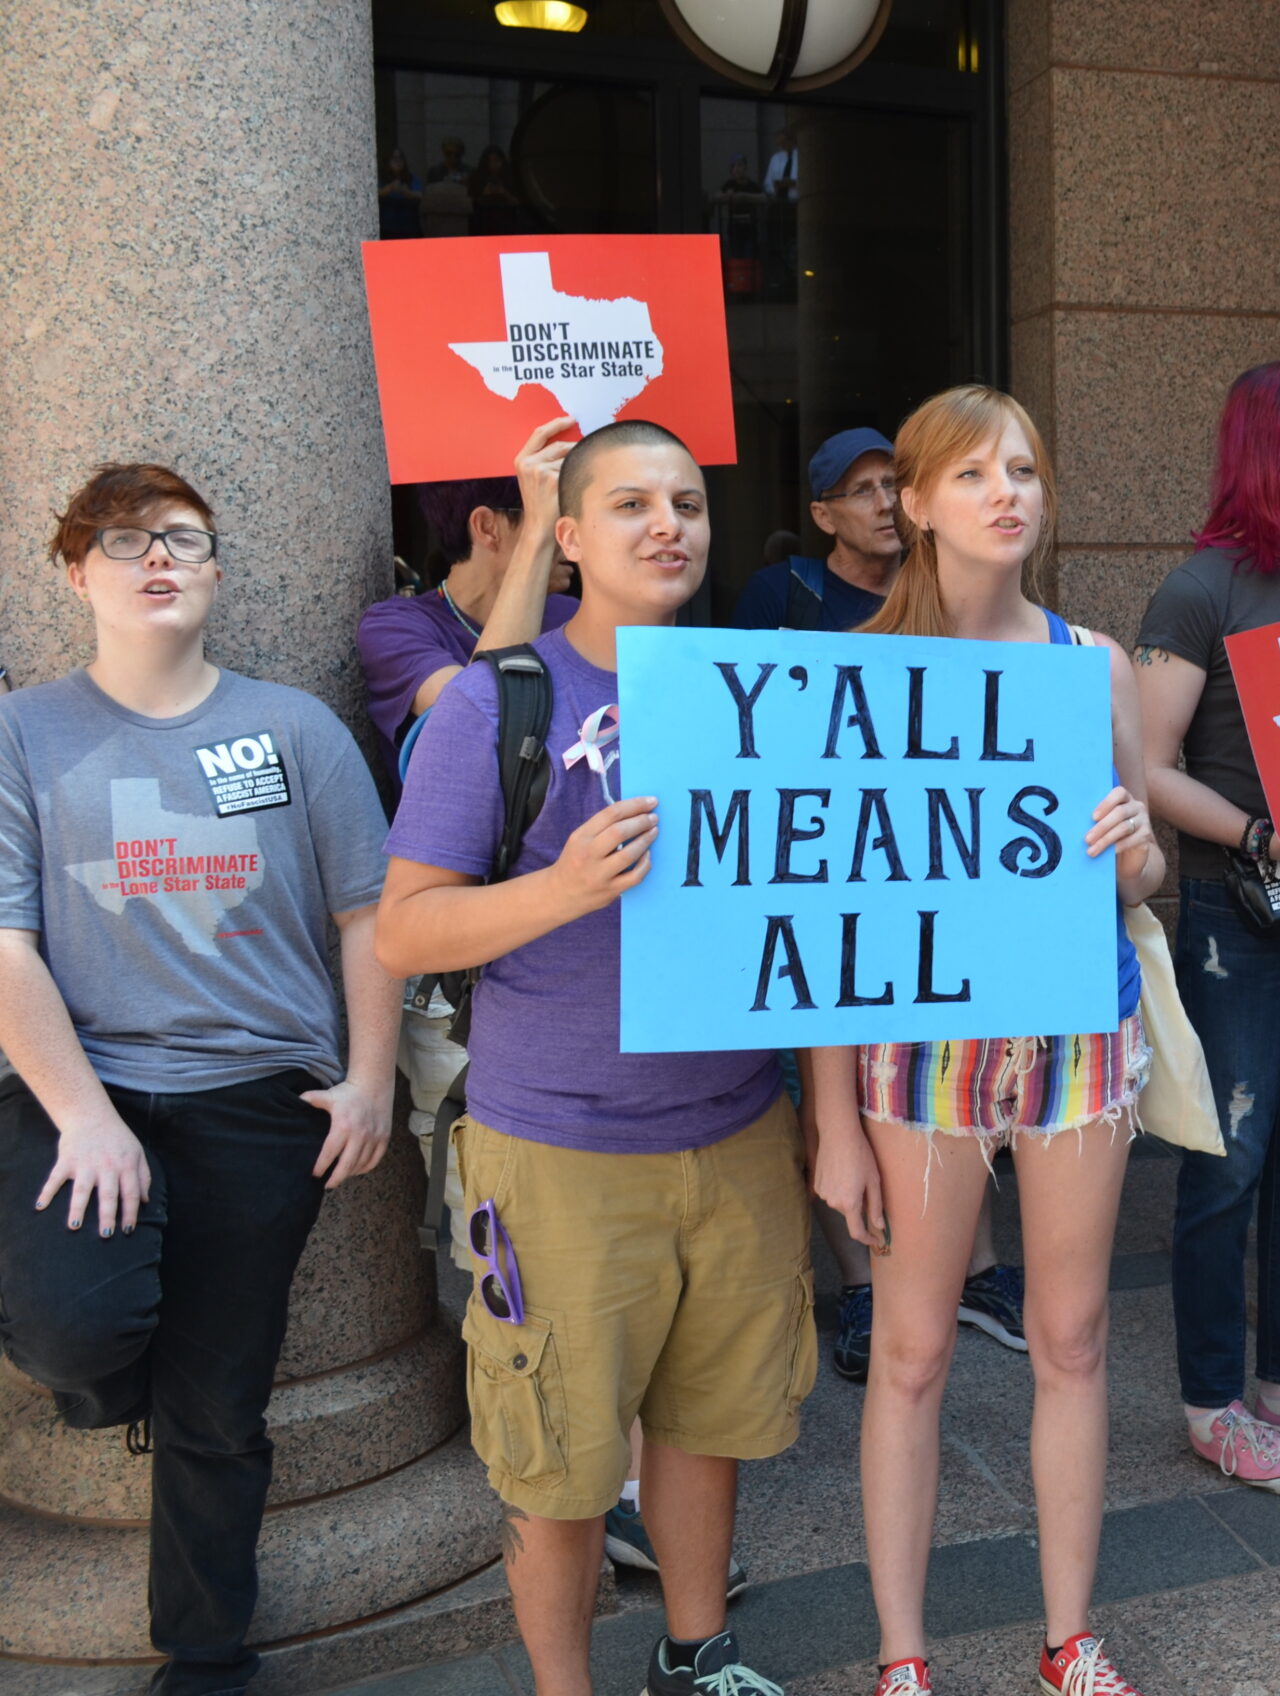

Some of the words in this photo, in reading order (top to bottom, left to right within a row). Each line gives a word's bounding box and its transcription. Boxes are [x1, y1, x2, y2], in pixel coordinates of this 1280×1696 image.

[509, 322, 570, 342] DON'T
[512, 340, 655, 362] DISCRIMINATE
[514, 364, 554, 380] Lone
[561, 362, 595, 378] Star
[601, 361, 643, 376] State
[713, 662, 1034, 762] Y'ALL
[196, 733, 279, 778] NO!
[212, 782, 243, 795] REFUSE
[243, 779, 254, 788] TO
[255, 773, 283, 786] ACCEPT
[254, 783, 286, 796] AMERICA
[681, 785, 1063, 887] MEANS
[116, 838, 177, 859] DON'T
[118, 854, 258, 879] DISCRIMINATE
[120, 881, 158, 896] Lone
[163, 877, 200, 893] Star
[205, 875, 246, 890] State
[748, 910, 972, 1012] ALL
